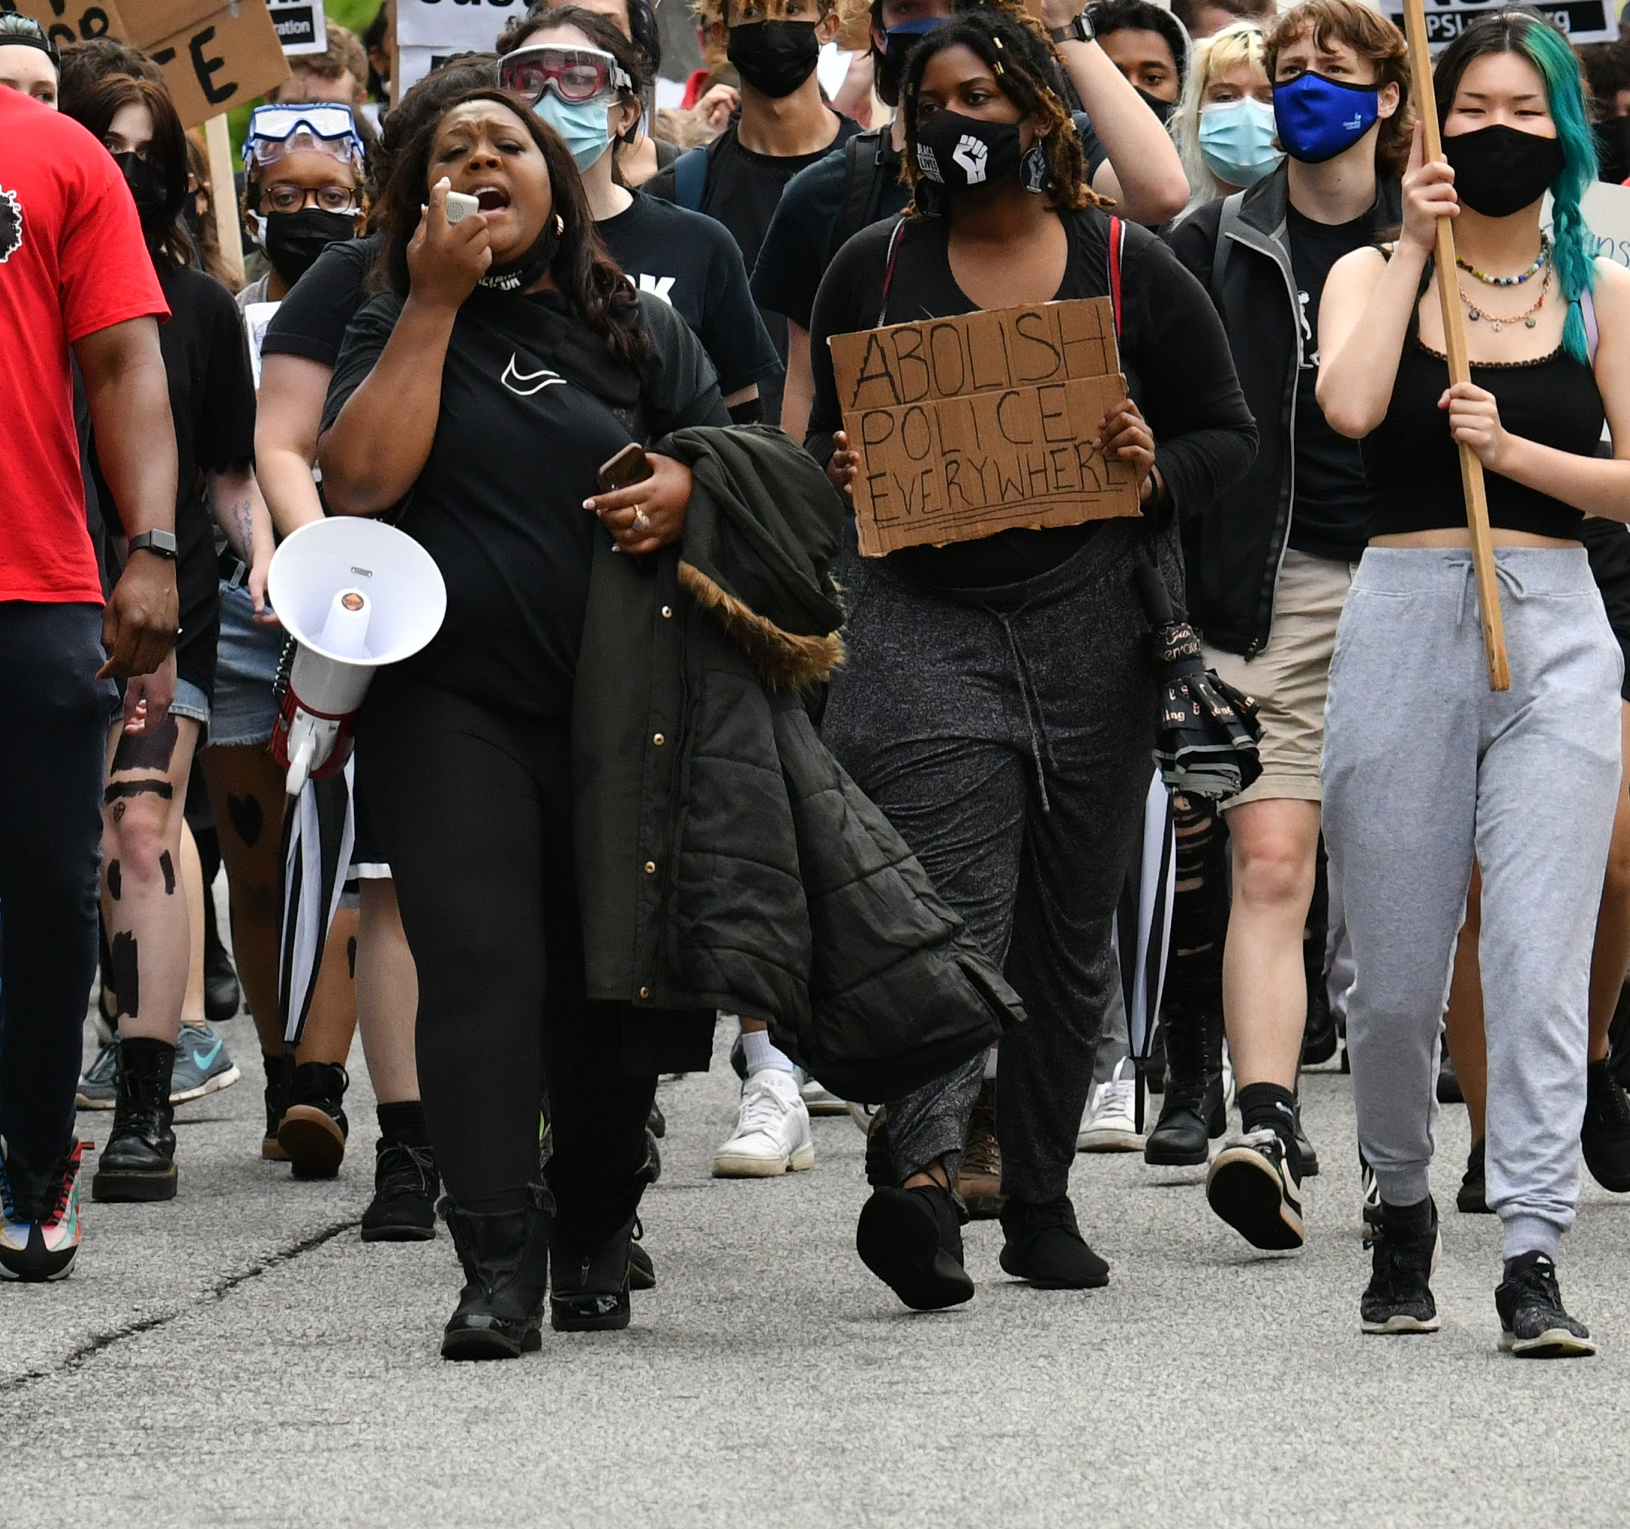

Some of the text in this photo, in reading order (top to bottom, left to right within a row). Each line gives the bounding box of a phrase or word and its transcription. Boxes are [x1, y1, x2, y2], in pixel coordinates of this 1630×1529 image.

[851, 304, 1109, 408] ABOLISH
[861, 384, 1078, 465] POLICE
[866, 440, 1129, 527] EVERYWHERE
